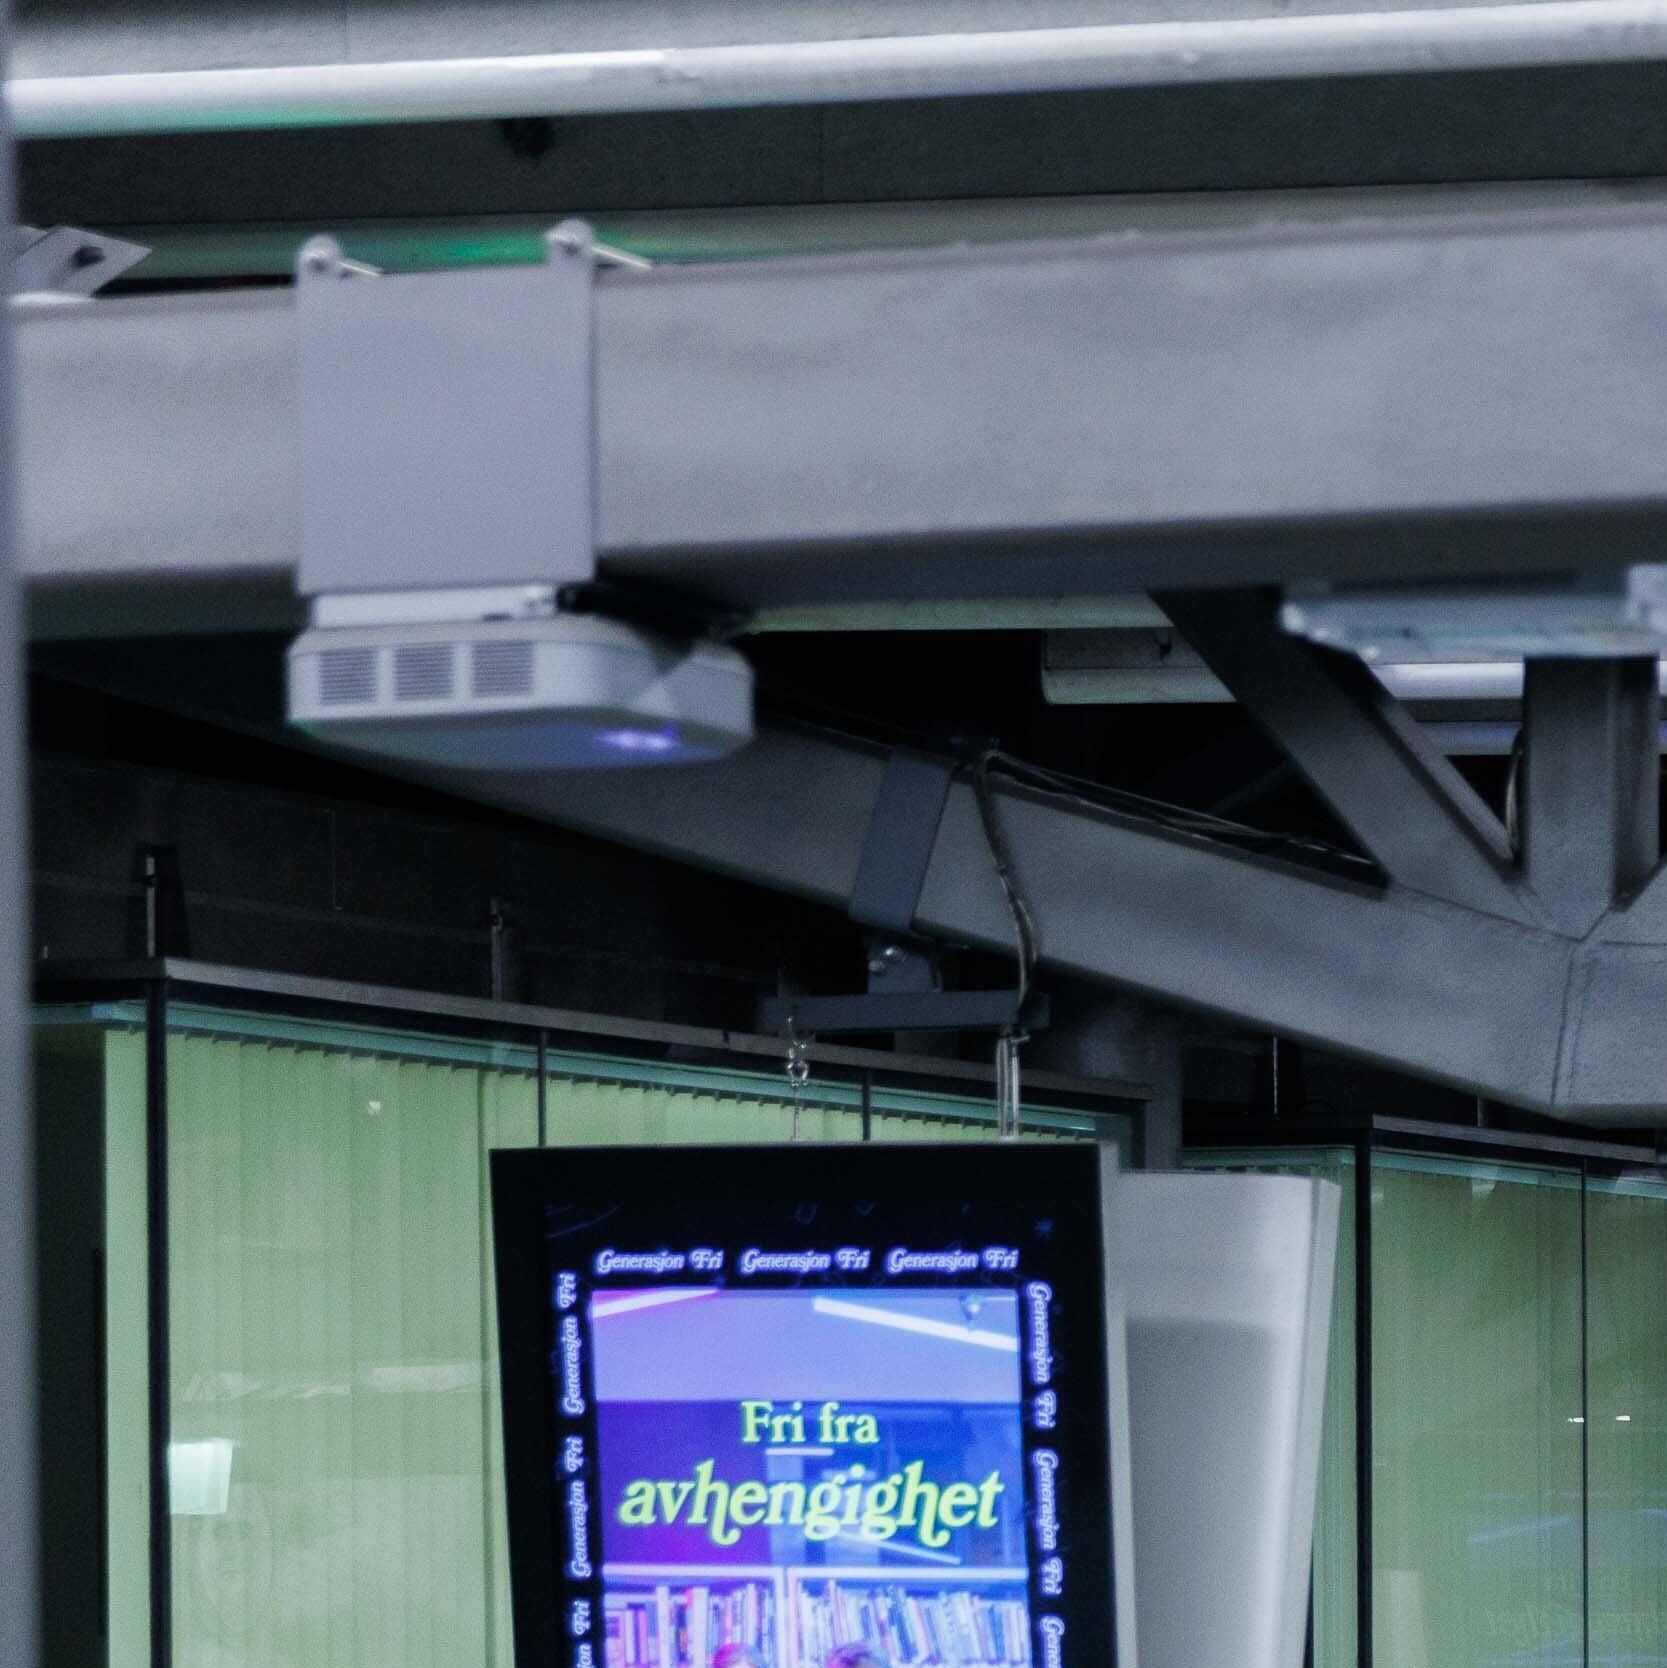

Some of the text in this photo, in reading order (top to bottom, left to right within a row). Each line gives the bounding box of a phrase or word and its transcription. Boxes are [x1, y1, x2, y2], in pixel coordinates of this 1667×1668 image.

[596, 1249, 723, 1274] Generasjon Fri
[740, 1248, 870, 1274] Generasjon Fri
[887, 1248, 1019, 1274] Generasjon Fri
[556, 1272, 585, 1415] Generasjon Fri
[1027, 1282, 1057, 1428] Generasjon Fri
[742, 1402, 879, 1444] Fri fra
[564, 1436, 592, 1578] Generasjon Fri
[618, 1461, 1005, 1546] avhengighet
[1032, 1450, 1063, 1595] Generasjon Fri
[571, 1600, 591, 1636] Fri
